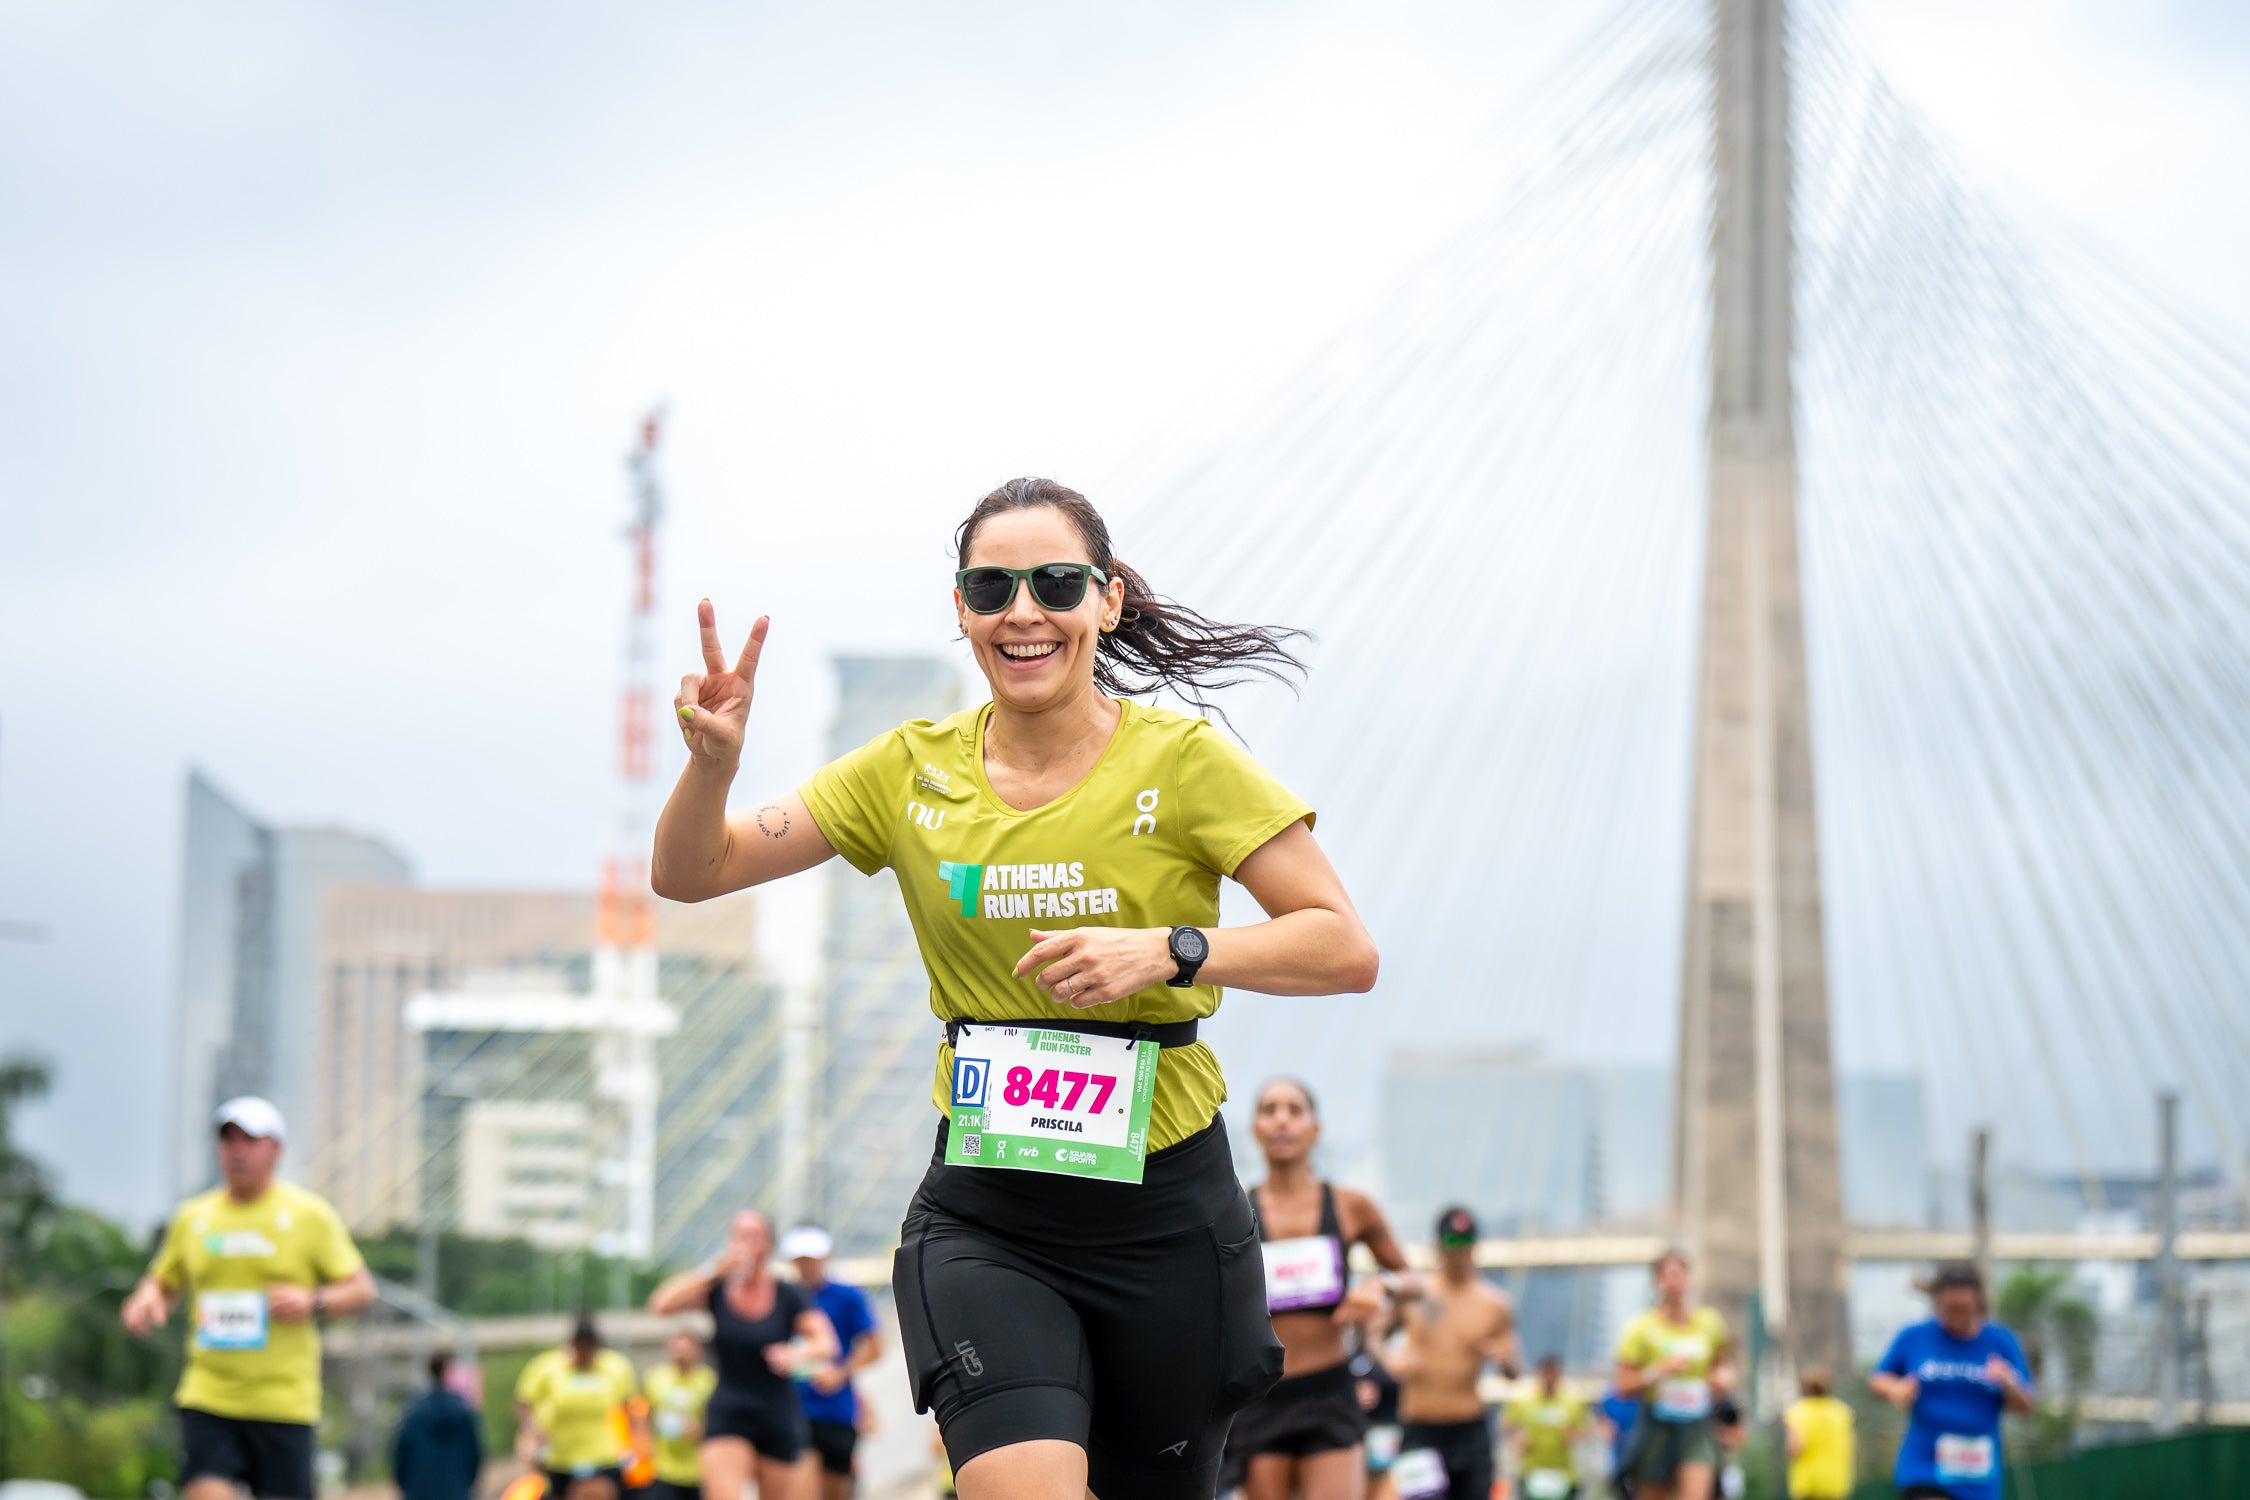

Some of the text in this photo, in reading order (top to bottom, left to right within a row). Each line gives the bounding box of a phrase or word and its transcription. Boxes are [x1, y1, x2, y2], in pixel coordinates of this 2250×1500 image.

[983, 862, 1085, 891] ATHENAS
[983, 887, 1119, 919] RUN FASTER
[1041, 1031, 1081, 1044] ATHENAS
[1039, 1041, 1092, 1057] RUN FASTER
[962, 1064, 980, 1099] D
[1003, 1065, 1117, 1115] 8477
[958, 1114, 982, 1127] 21.1K
[1031, 1117, 1083, 1133] PRISCILA
[1128, 1132, 1140, 1156] 8477
[1068, 1156, 1097, 1166] SPORTS
[1069, 1150, 1097, 1160] IGUANA
[953, 1339, 984, 1377] GRIT
